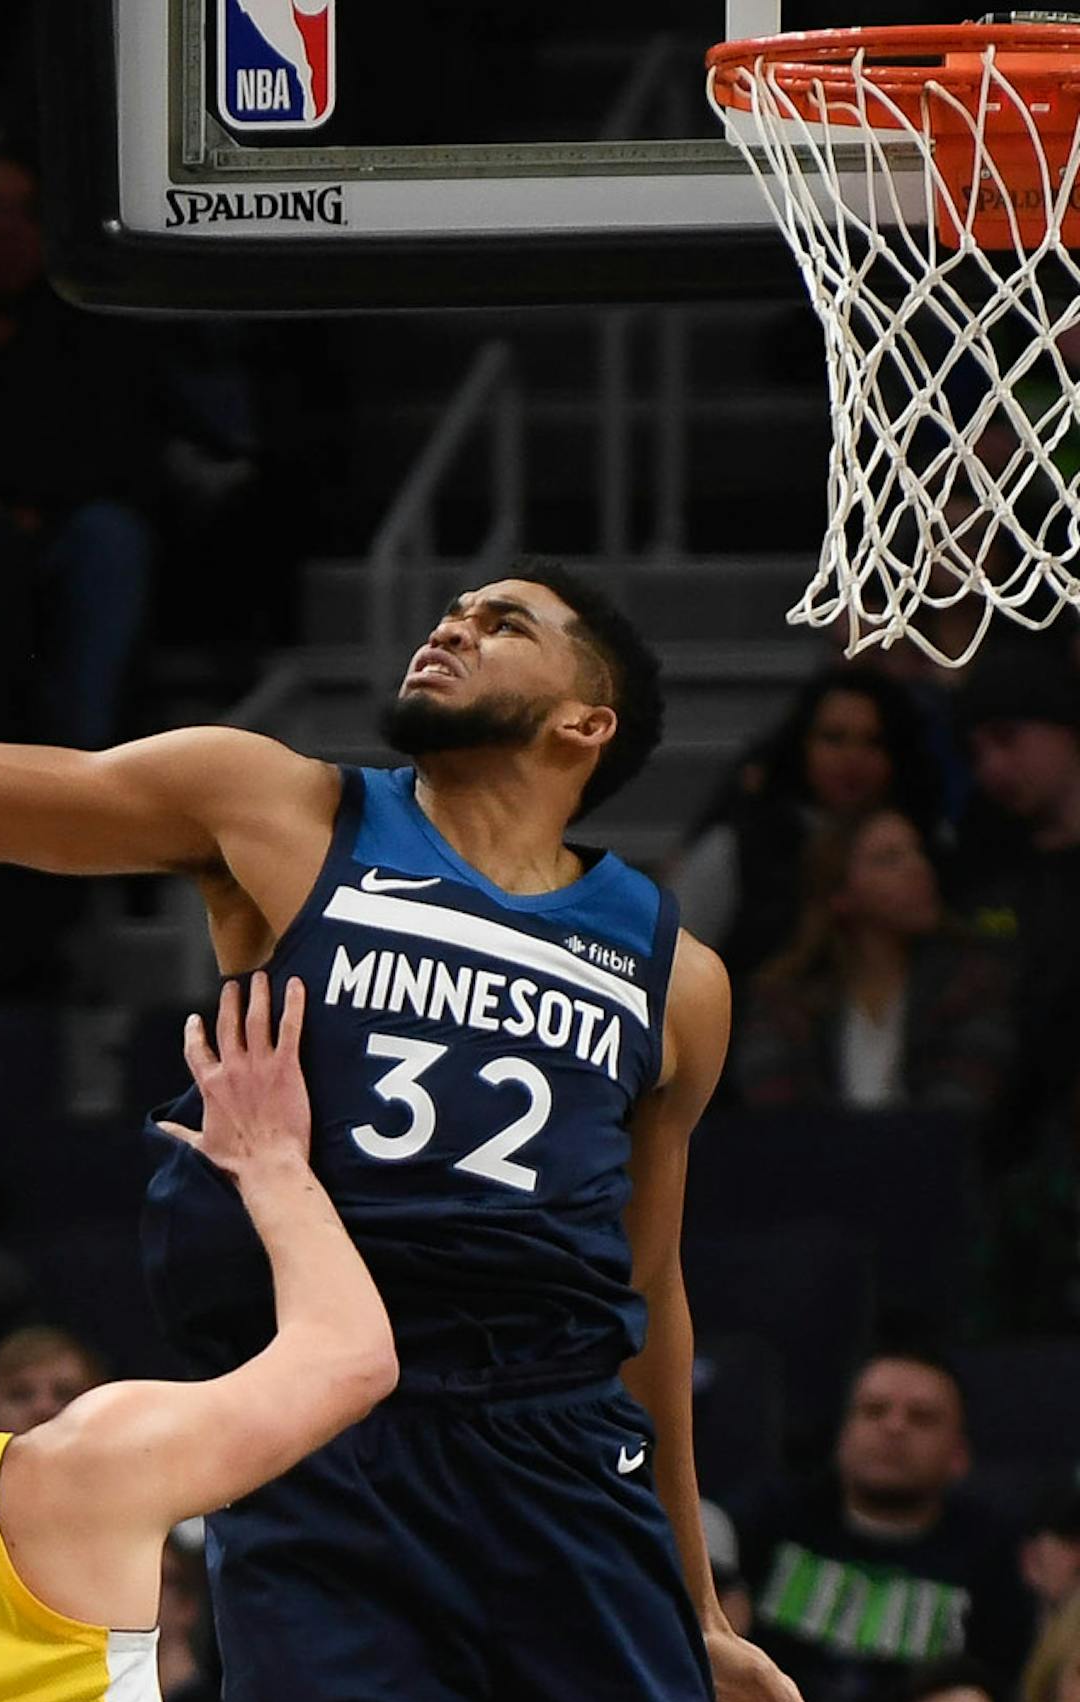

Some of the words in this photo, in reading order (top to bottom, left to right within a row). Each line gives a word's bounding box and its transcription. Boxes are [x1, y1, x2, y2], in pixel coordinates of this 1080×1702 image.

[236, 67, 291, 111] NBA
[165, 185, 344, 228] SPALDING
[588, 942, 637, 977] fitbit
[324, 945, 622, 1081] MINNESOTA
[350, 1032, 553, 1193] 32
